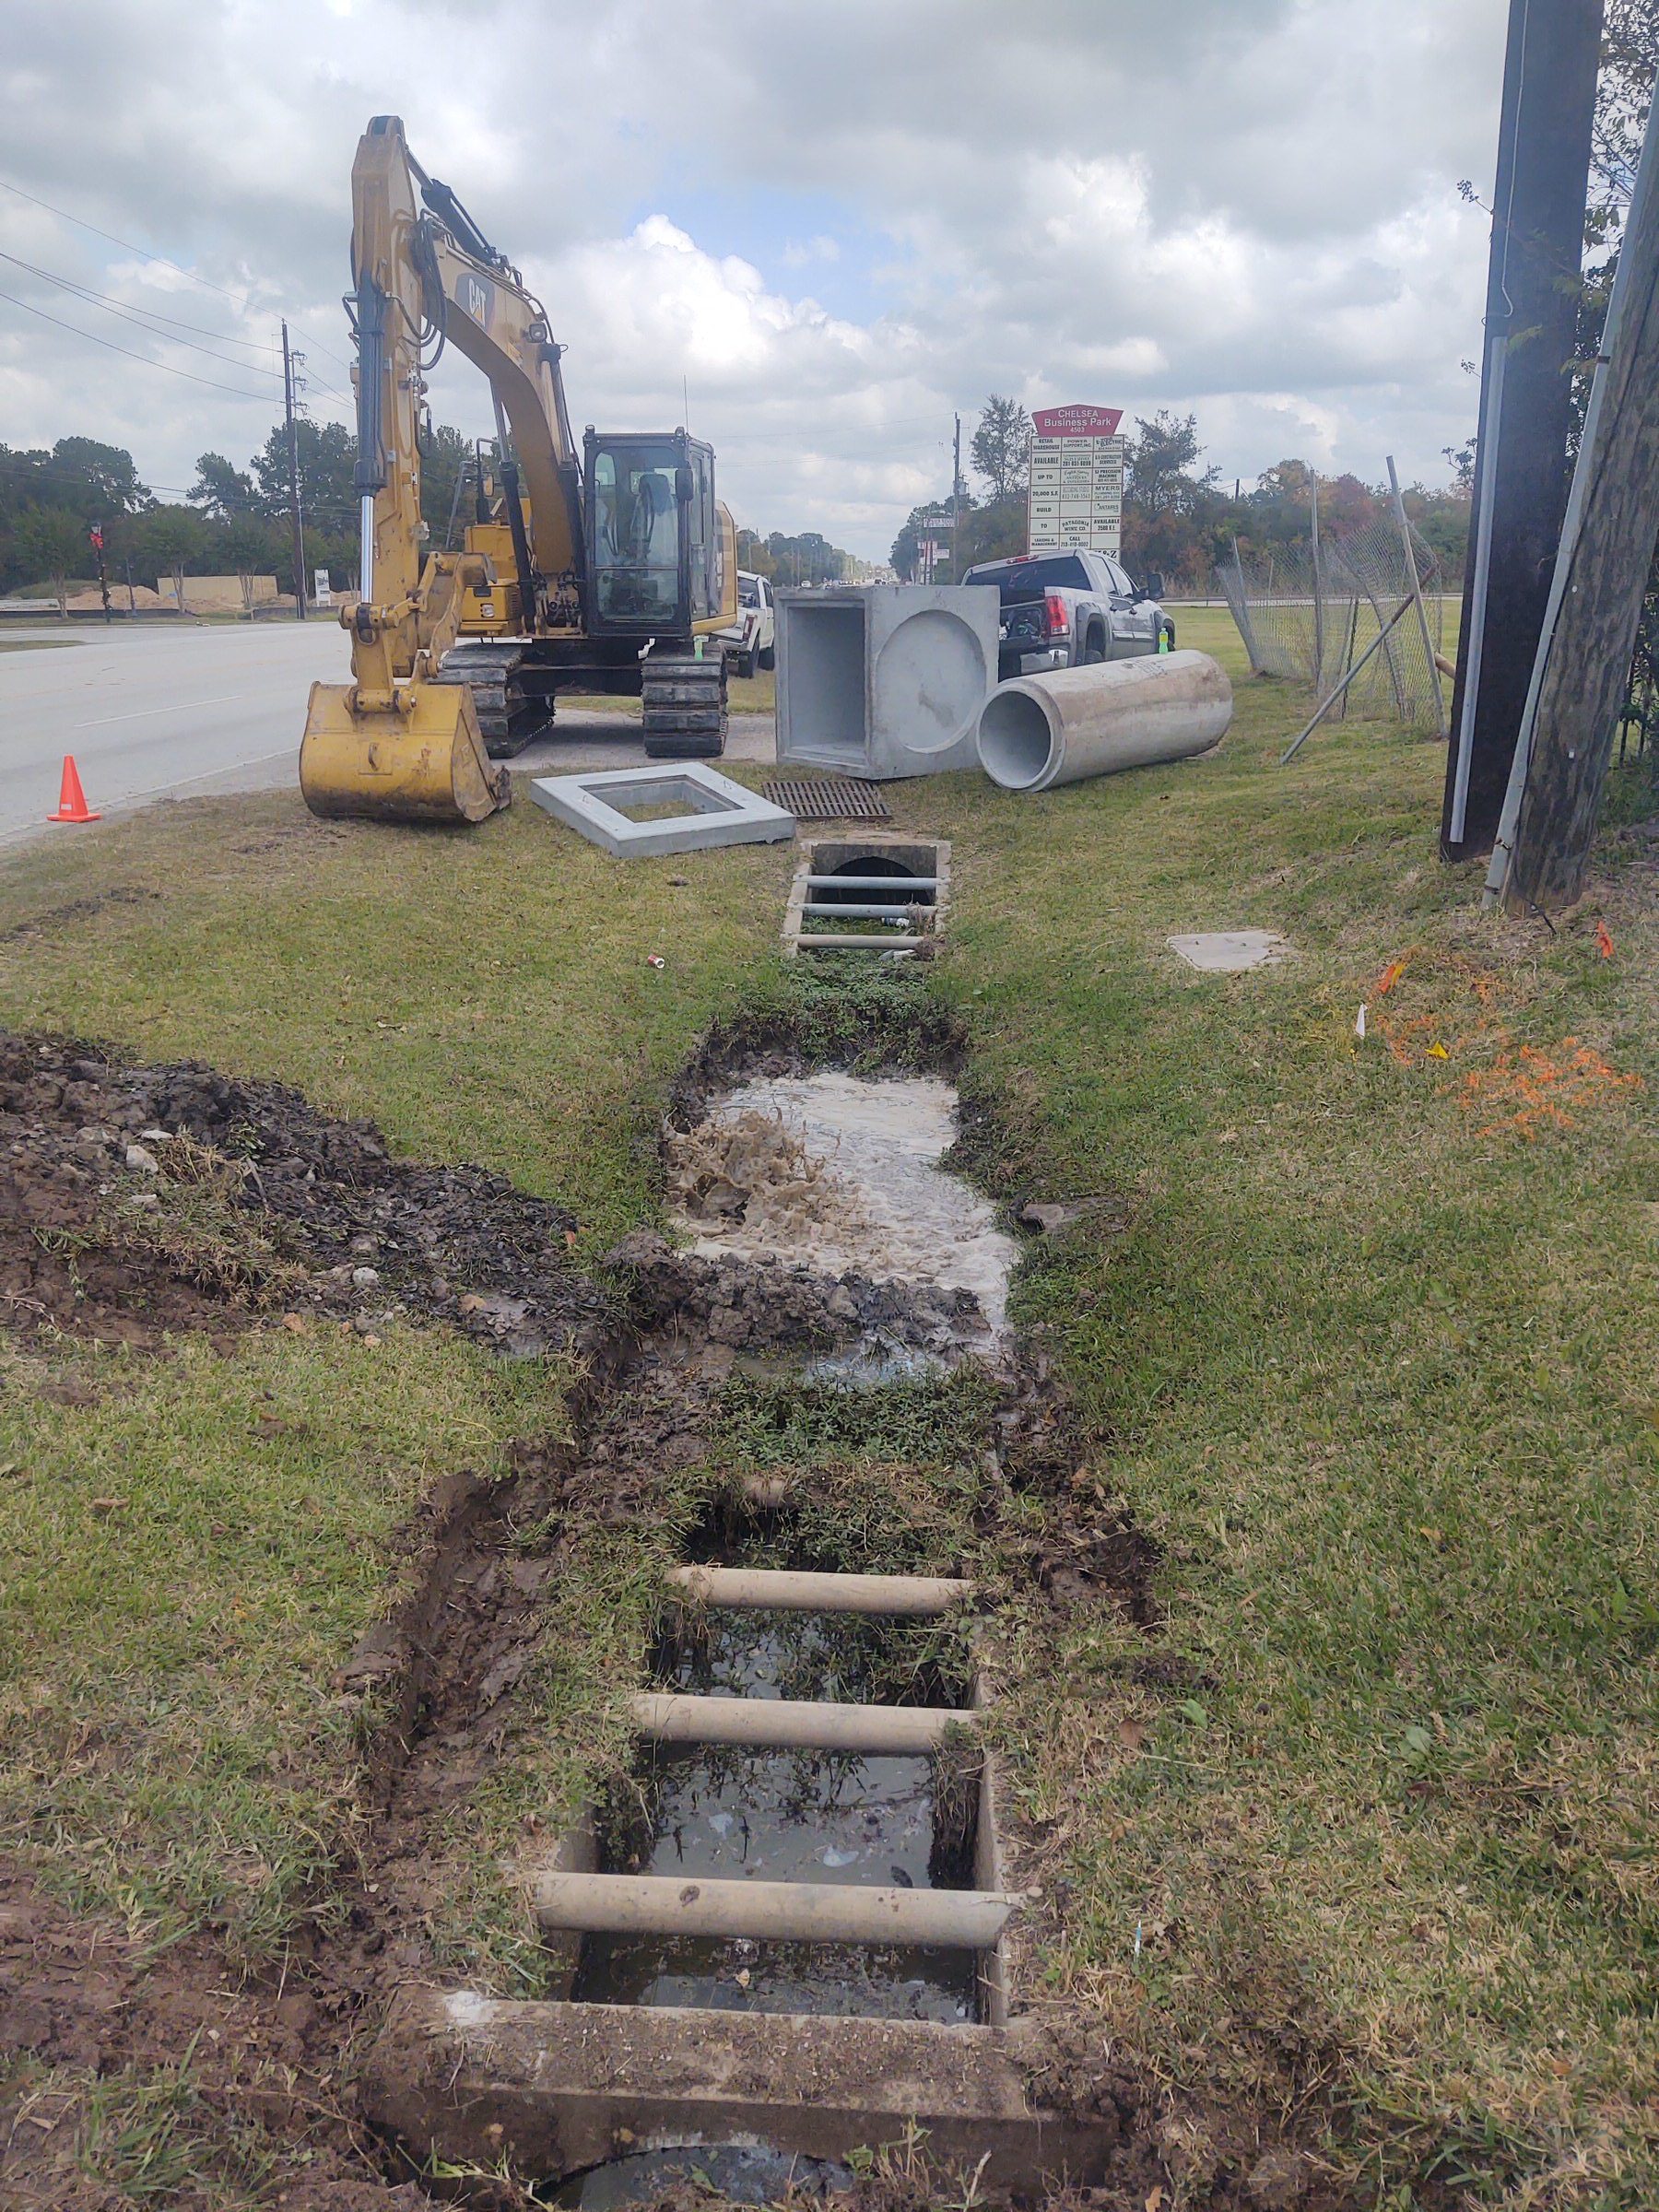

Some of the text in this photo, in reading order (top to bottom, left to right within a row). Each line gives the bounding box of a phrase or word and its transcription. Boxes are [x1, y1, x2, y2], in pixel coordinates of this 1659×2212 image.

[468, 278, 487, 326] CAT
[1058, 409, 1099, 418] CHELSEA
[1090, 418, 1111, 426] Park
